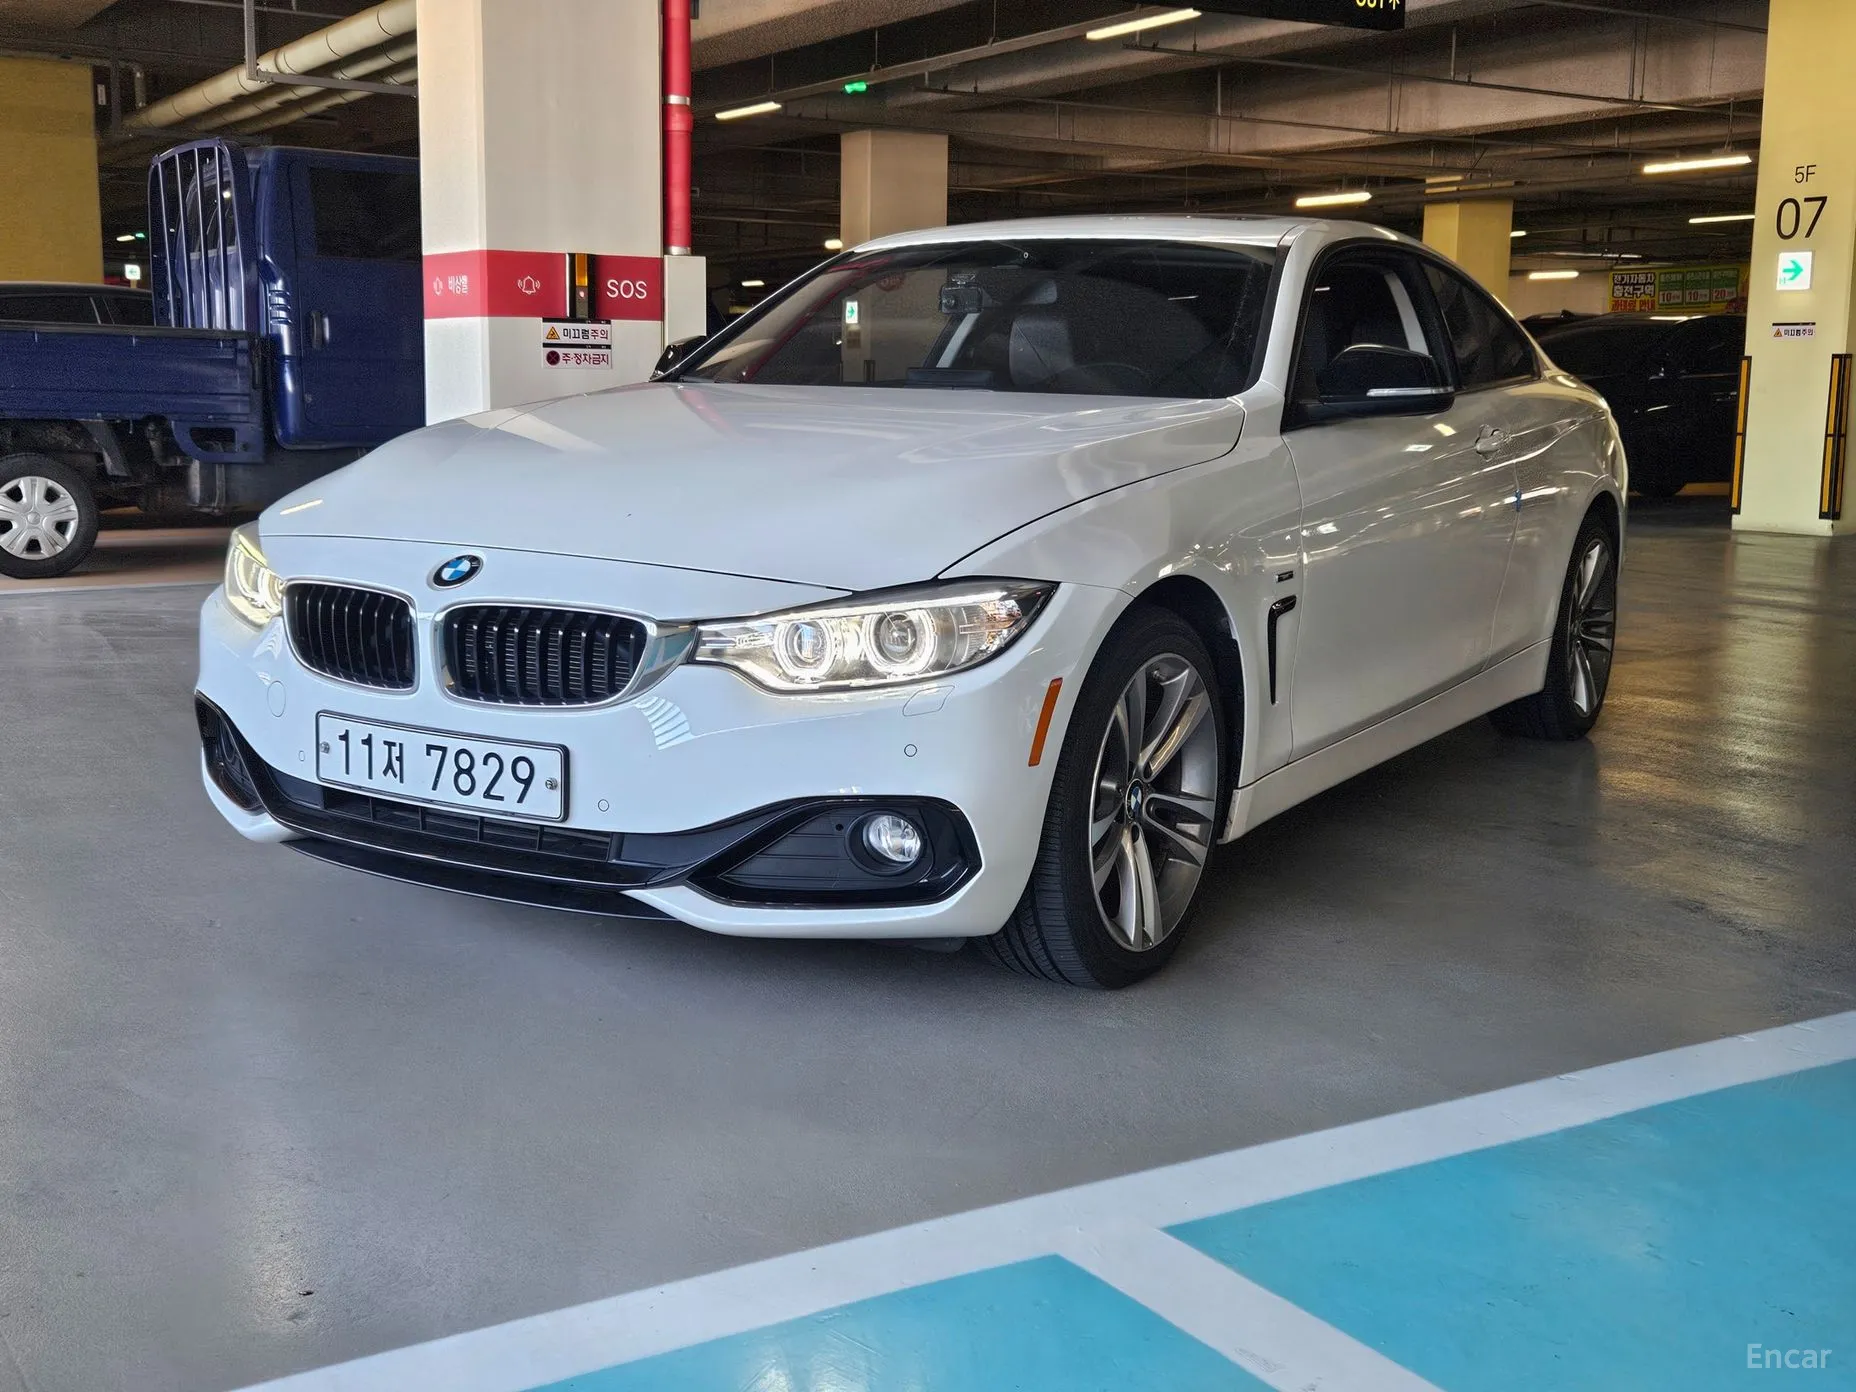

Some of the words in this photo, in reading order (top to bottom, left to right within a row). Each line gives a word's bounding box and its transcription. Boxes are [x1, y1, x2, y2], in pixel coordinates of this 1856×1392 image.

[1794, 164, 1817, 184] 5F
[1775, 195, 1828, 241] 07
[447, 275, 468, 295] 비상벨
[606, 279, 648, 300] SOS
[338, 729, 404, 784] 11저
[425, 743, 535, 804] 7829
